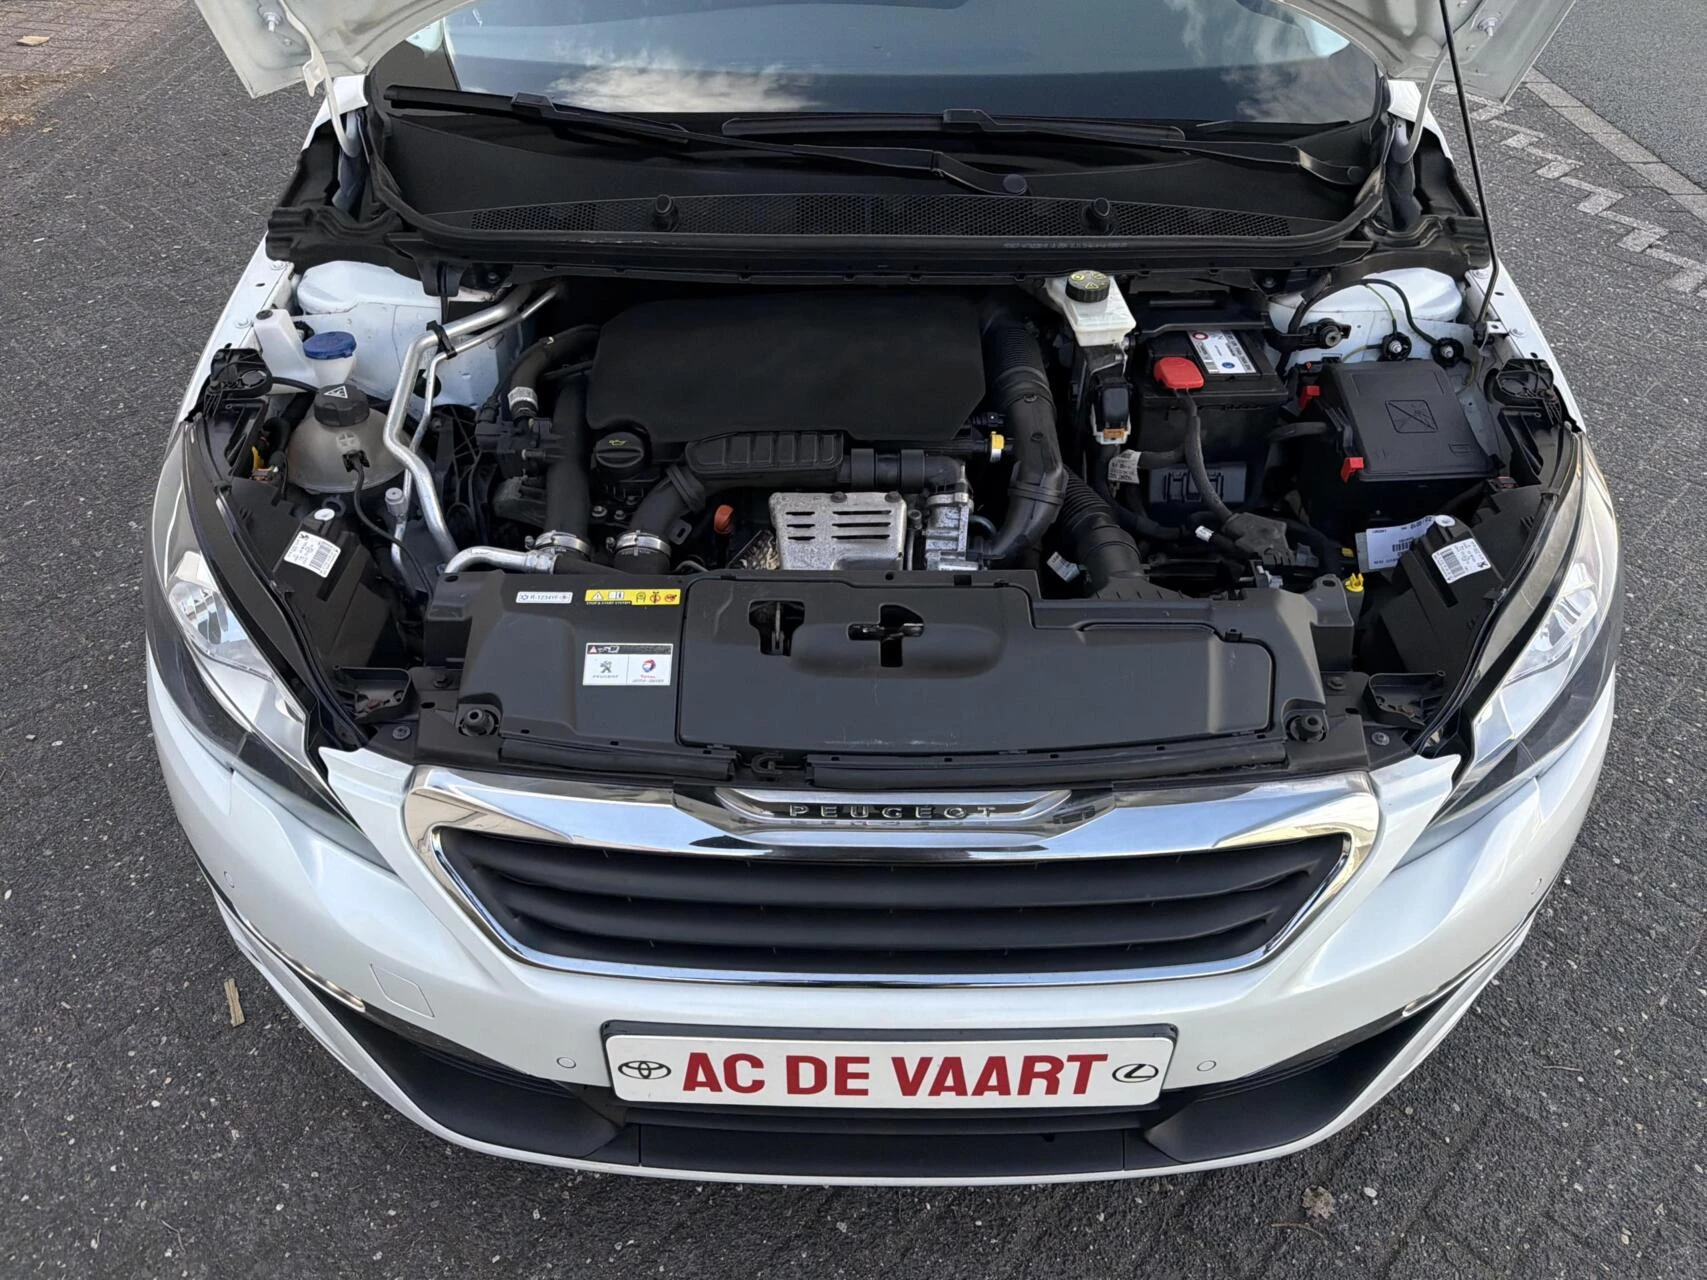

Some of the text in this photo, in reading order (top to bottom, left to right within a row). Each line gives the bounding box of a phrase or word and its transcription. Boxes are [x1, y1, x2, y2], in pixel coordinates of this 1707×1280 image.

[789, 804, 996, 819] PEUGEOT
[683, 1052, 1108, 1096] AC DE VAART
